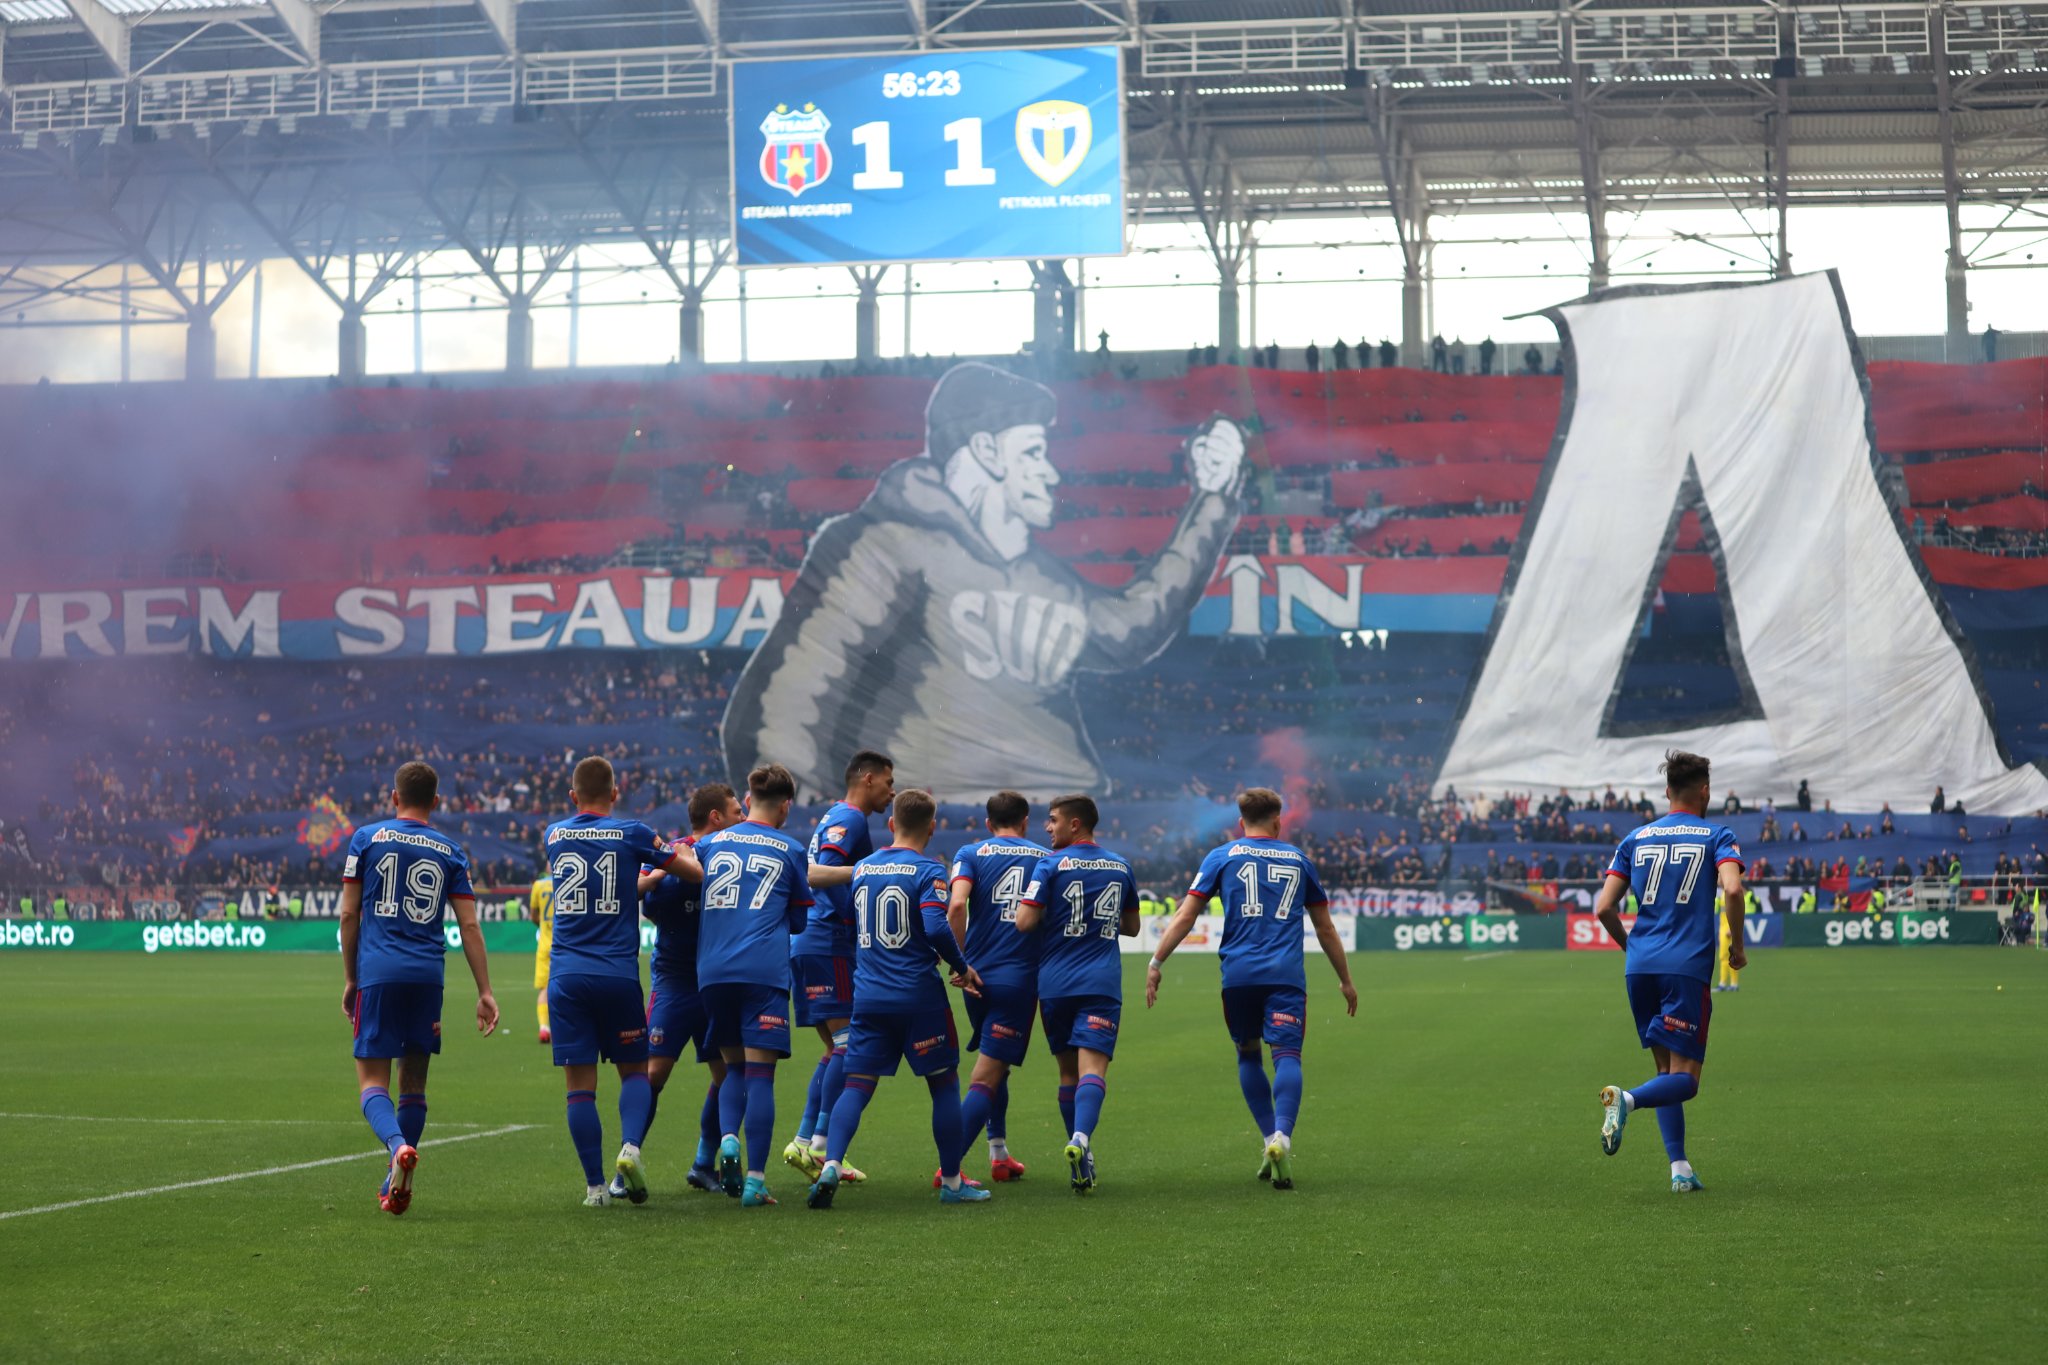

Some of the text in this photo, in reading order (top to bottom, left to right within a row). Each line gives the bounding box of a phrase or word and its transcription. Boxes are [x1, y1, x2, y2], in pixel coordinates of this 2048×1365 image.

[882, 70, 961, 98] 56:23
[852, 117, 996, 190] 1 1
[742, 206, 788, 219] STEAUA
[999, 196, 1057, 209] PETROLUL
[335, 576, 785, 656] STEAUA
[388, 832, 450, 855] Porotherm
[558, 829, 622, 841] Porotherm
[725, 832, 787, 850] Porotherm
[1650, 826, 1710, 836] Porotherm
[1073, 859, 1126, 872] Porotherm
[1243, 847, 1301, 860] Porotherm
[705, 851, 784, 910] 27
[863, 864, 915, 875] Porotherm
[1635, 844, 1705, 904] 77
[374, 852, 444, 924] 19
[554, 852, 620, 914] 21
[992, 866, 1025, 922] 4
[1237, 862, 1300, 919] 17
[854, 885, 911, 949] 10
[1062, 881, 1122, 940] 14
[142, 919, 266, 953] getsbet.ro
[1470, 919, 1519, 943] bet
[1902, 915, 1949, 939] bet
[761, 1015, 782, 1024] STEAUA
